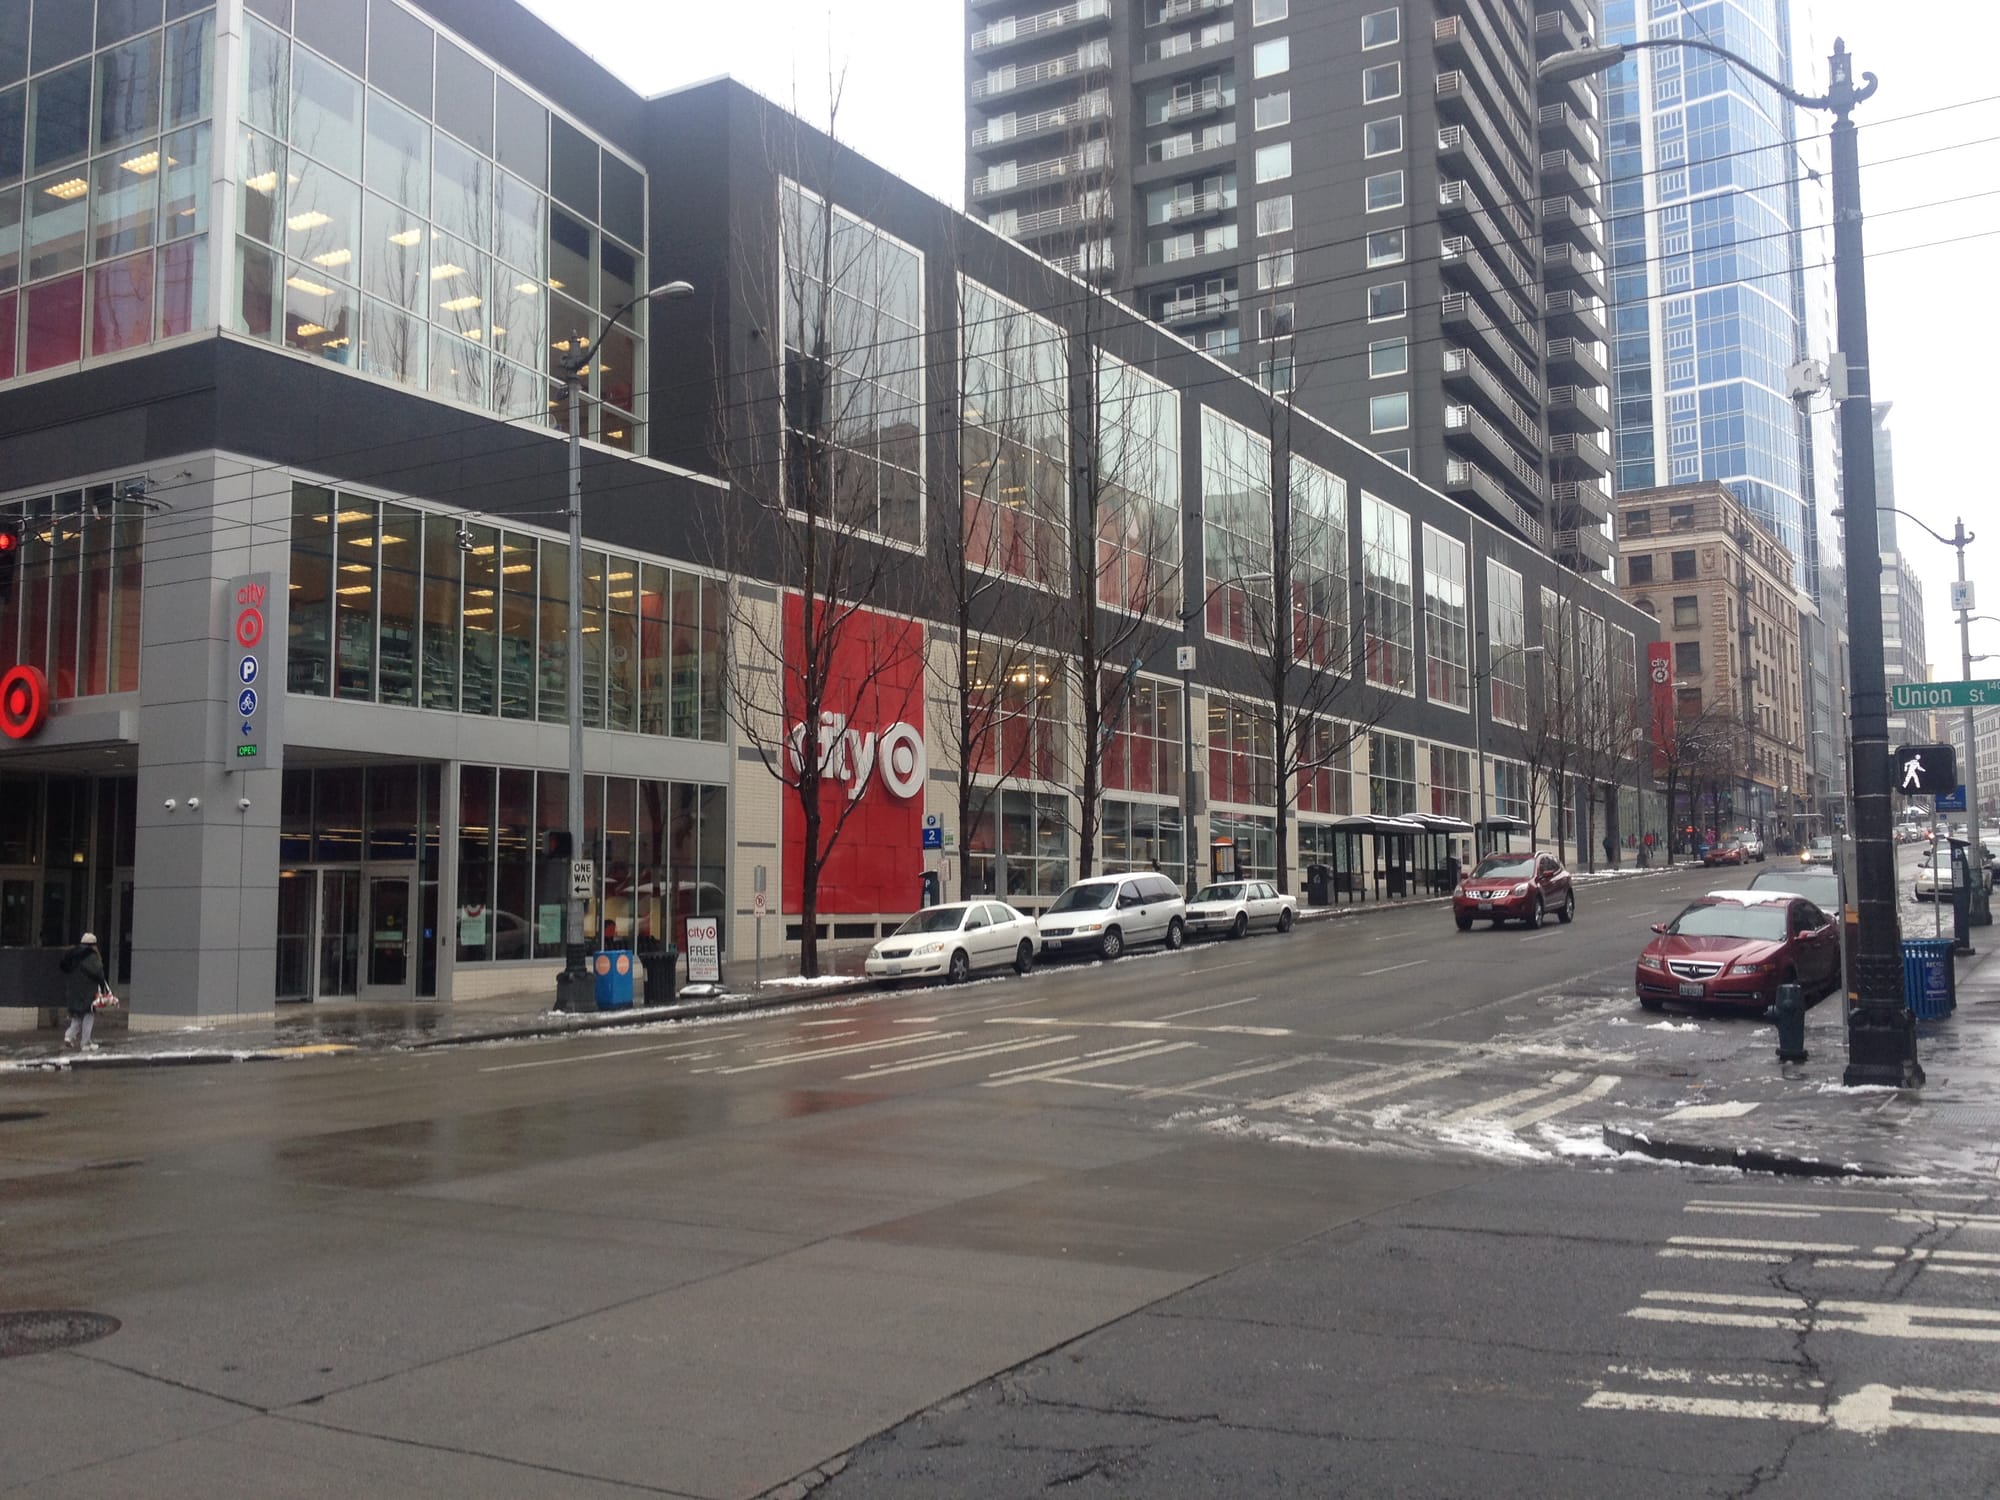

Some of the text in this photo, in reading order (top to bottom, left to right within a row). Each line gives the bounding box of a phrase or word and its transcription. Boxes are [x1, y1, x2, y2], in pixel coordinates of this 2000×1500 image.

[237, 583, 266, 608] city
[243, 661, 254, 680] P
[1898, 686, 1985, 706] Union St
[239, 745, 257, 756] OPEN
[929, 817, 936, 826] P
[928, 830, 936, 841] 2
[574, 863, 591, 873] ONE
[574, 873, 592, 883] WAY
[688, 926, 706, 940] city
[689, 945, 716, 956] FREE
[690, 957, 717, 965] PARKING
